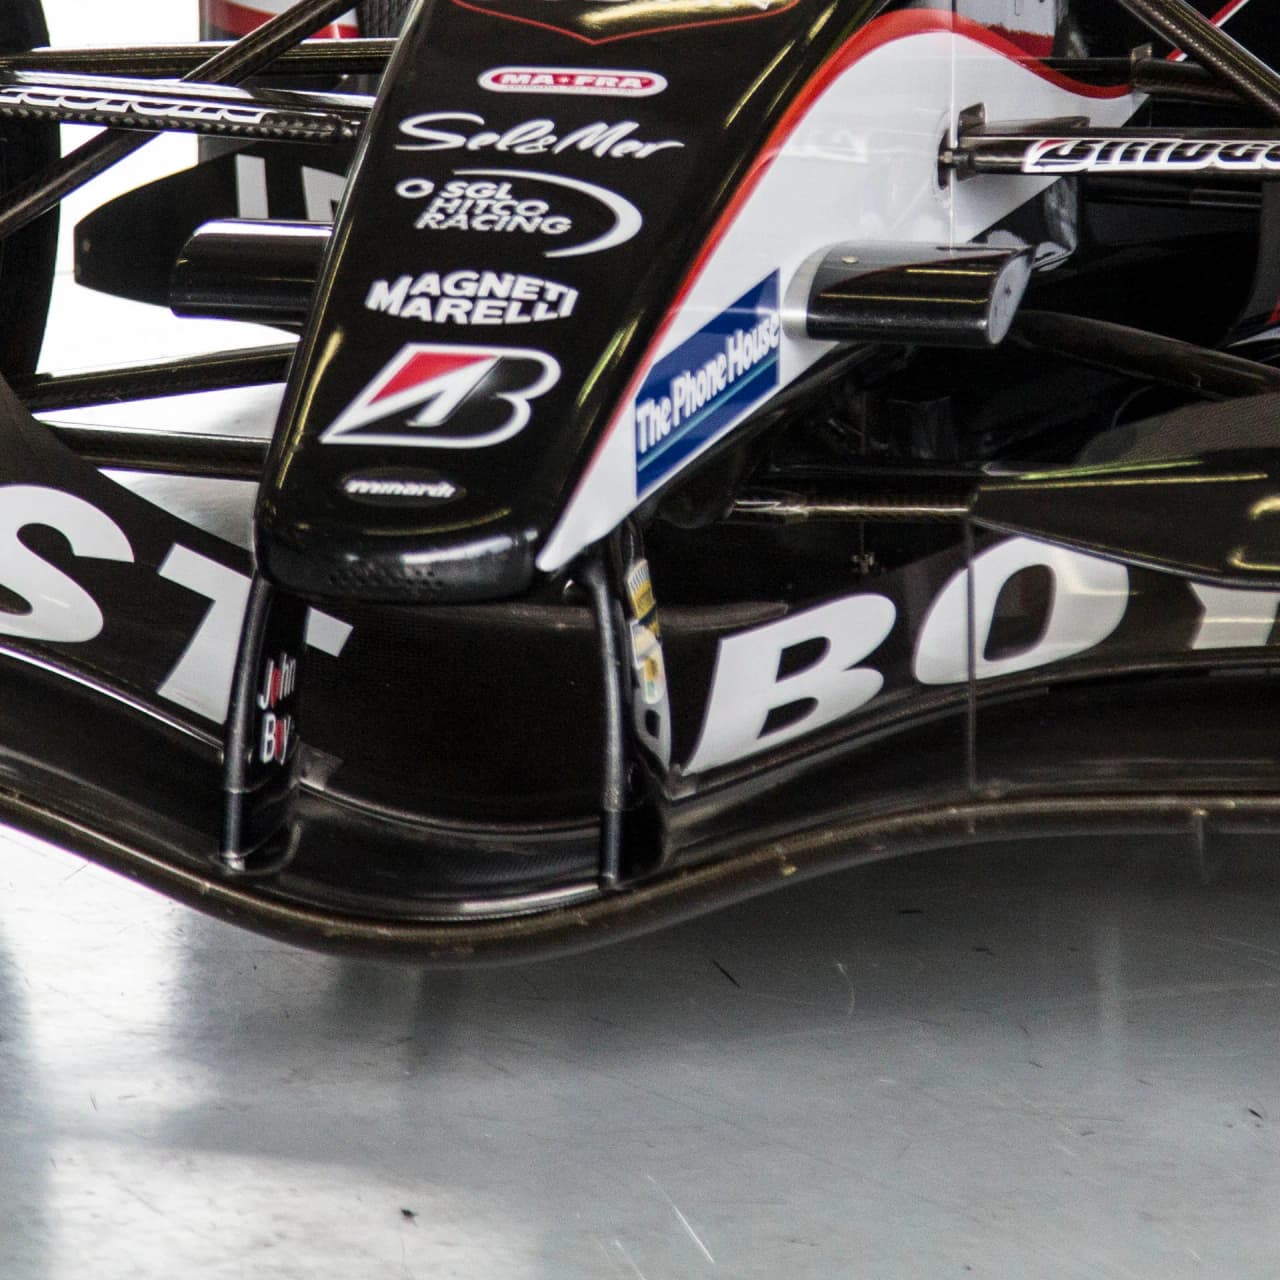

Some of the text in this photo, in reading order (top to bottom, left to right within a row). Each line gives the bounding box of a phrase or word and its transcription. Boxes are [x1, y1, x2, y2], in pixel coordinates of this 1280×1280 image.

[440, 180, 515, 200] SGL
[427, 198, 551, 217] HITCO
[414, 212, 572, 235] RACING
[636, 312, 780, 454] The Phone House
